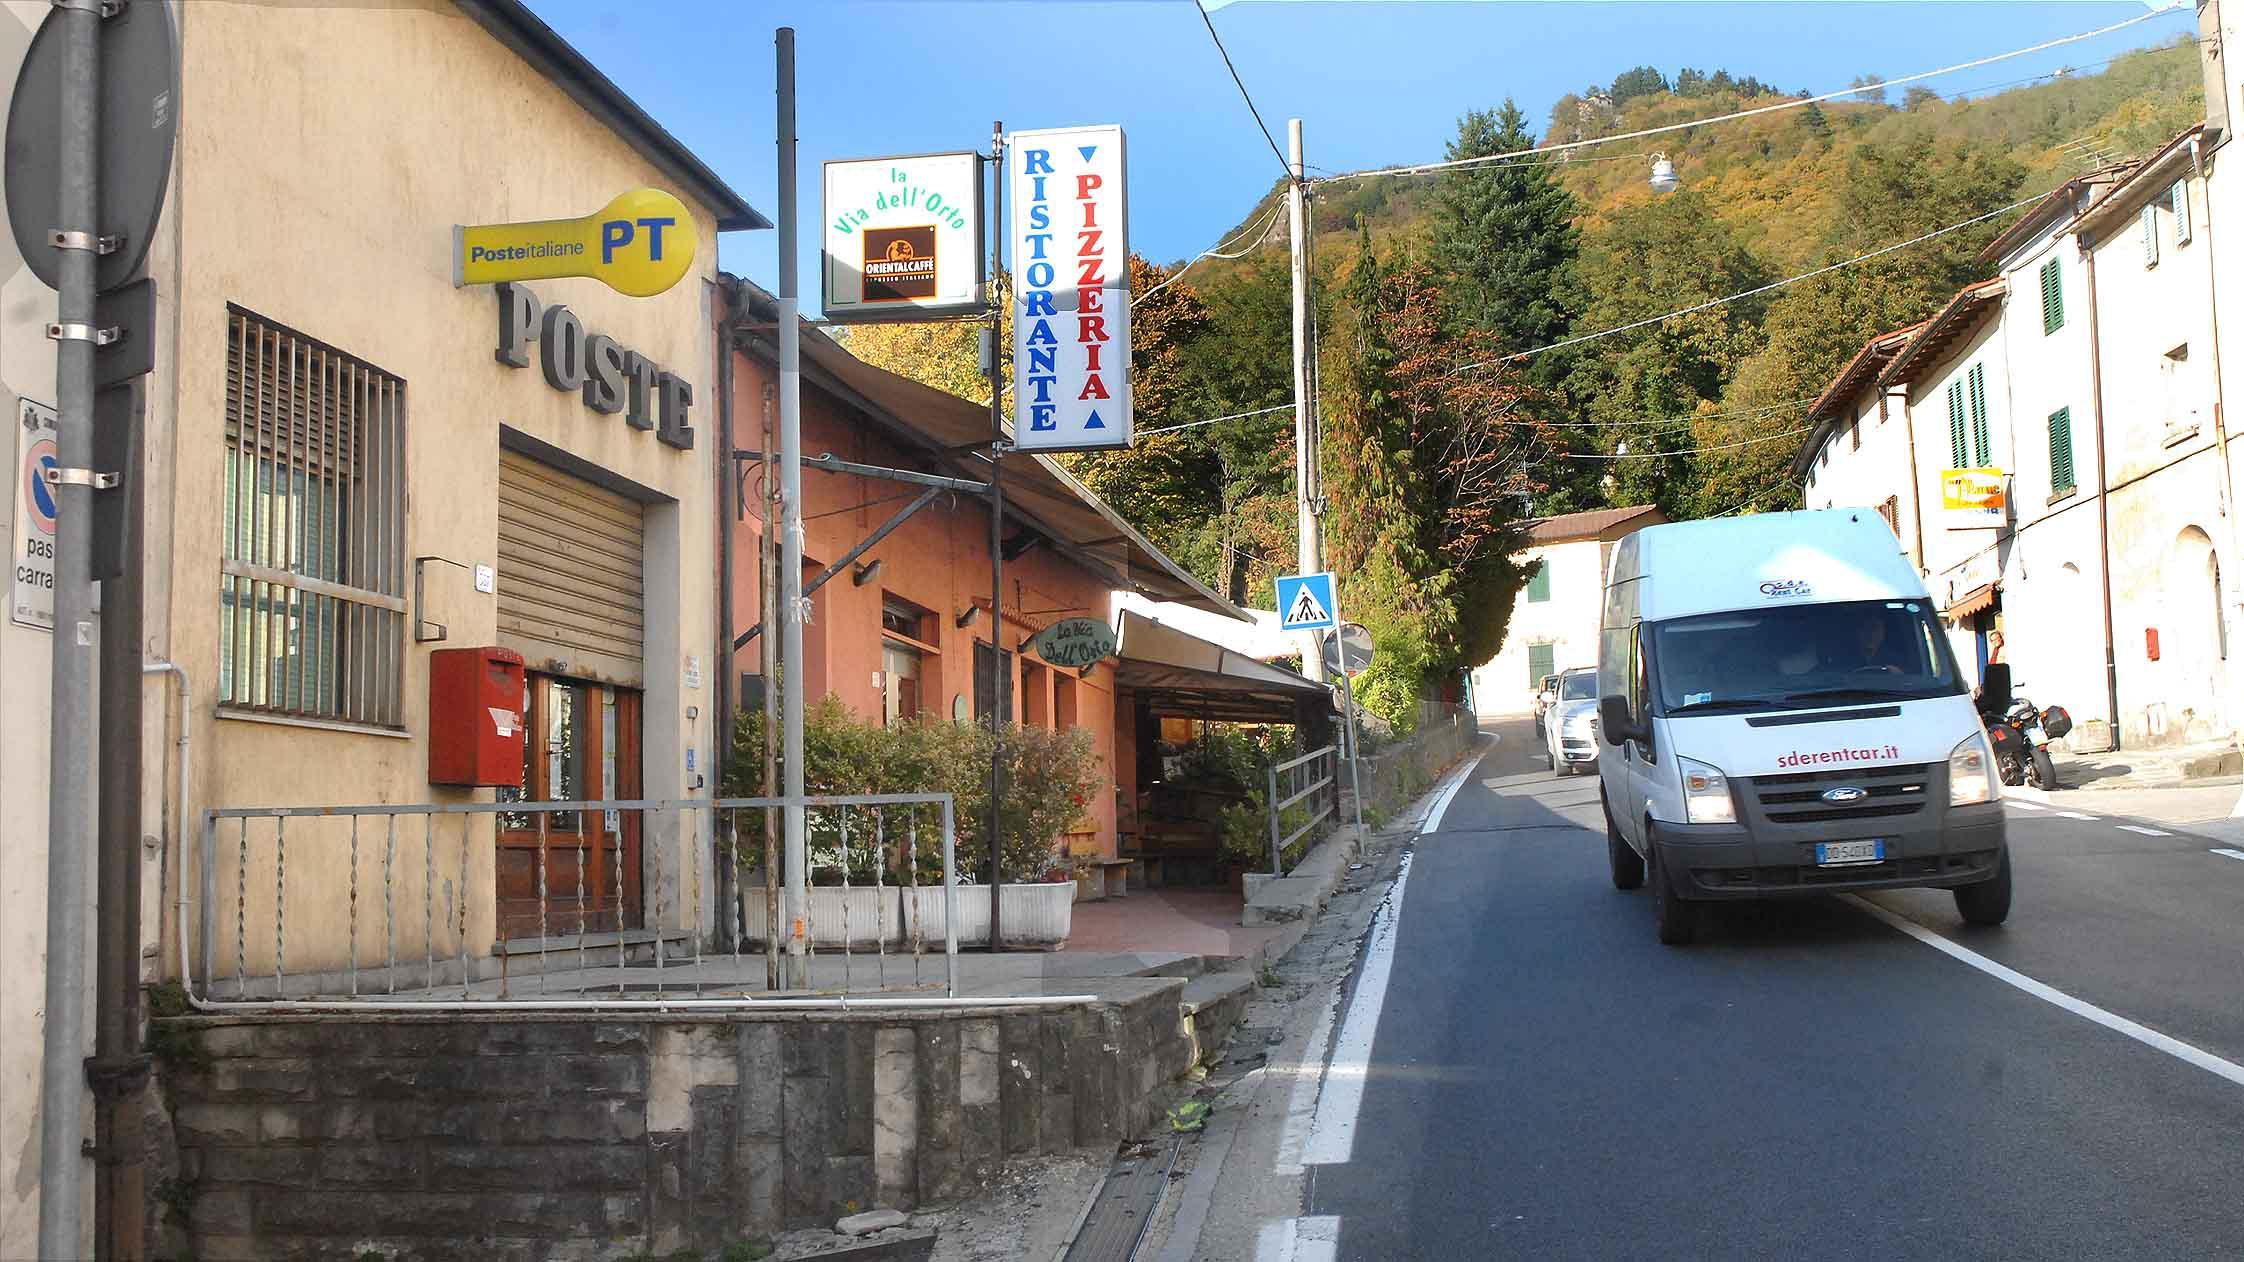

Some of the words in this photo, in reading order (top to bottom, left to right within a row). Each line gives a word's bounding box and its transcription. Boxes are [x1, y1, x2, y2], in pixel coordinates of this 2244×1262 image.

[891, 167, 907, 183] la
[834, 208, 870, 235] Via
[876, 186, 965, 230] dell'Orto
[601, 217, 676, 265] PT
[1023, 149, 1058, 431] RISTORANTE
[1075, 174, 1110, 400] PIZZERIA
[494, 281, 695, 450] POSTE
[27, 538, 54, 559] pas
[17, 565, 54, 589] carra
[1777, 745, 1899, 768] sderentcar.it
